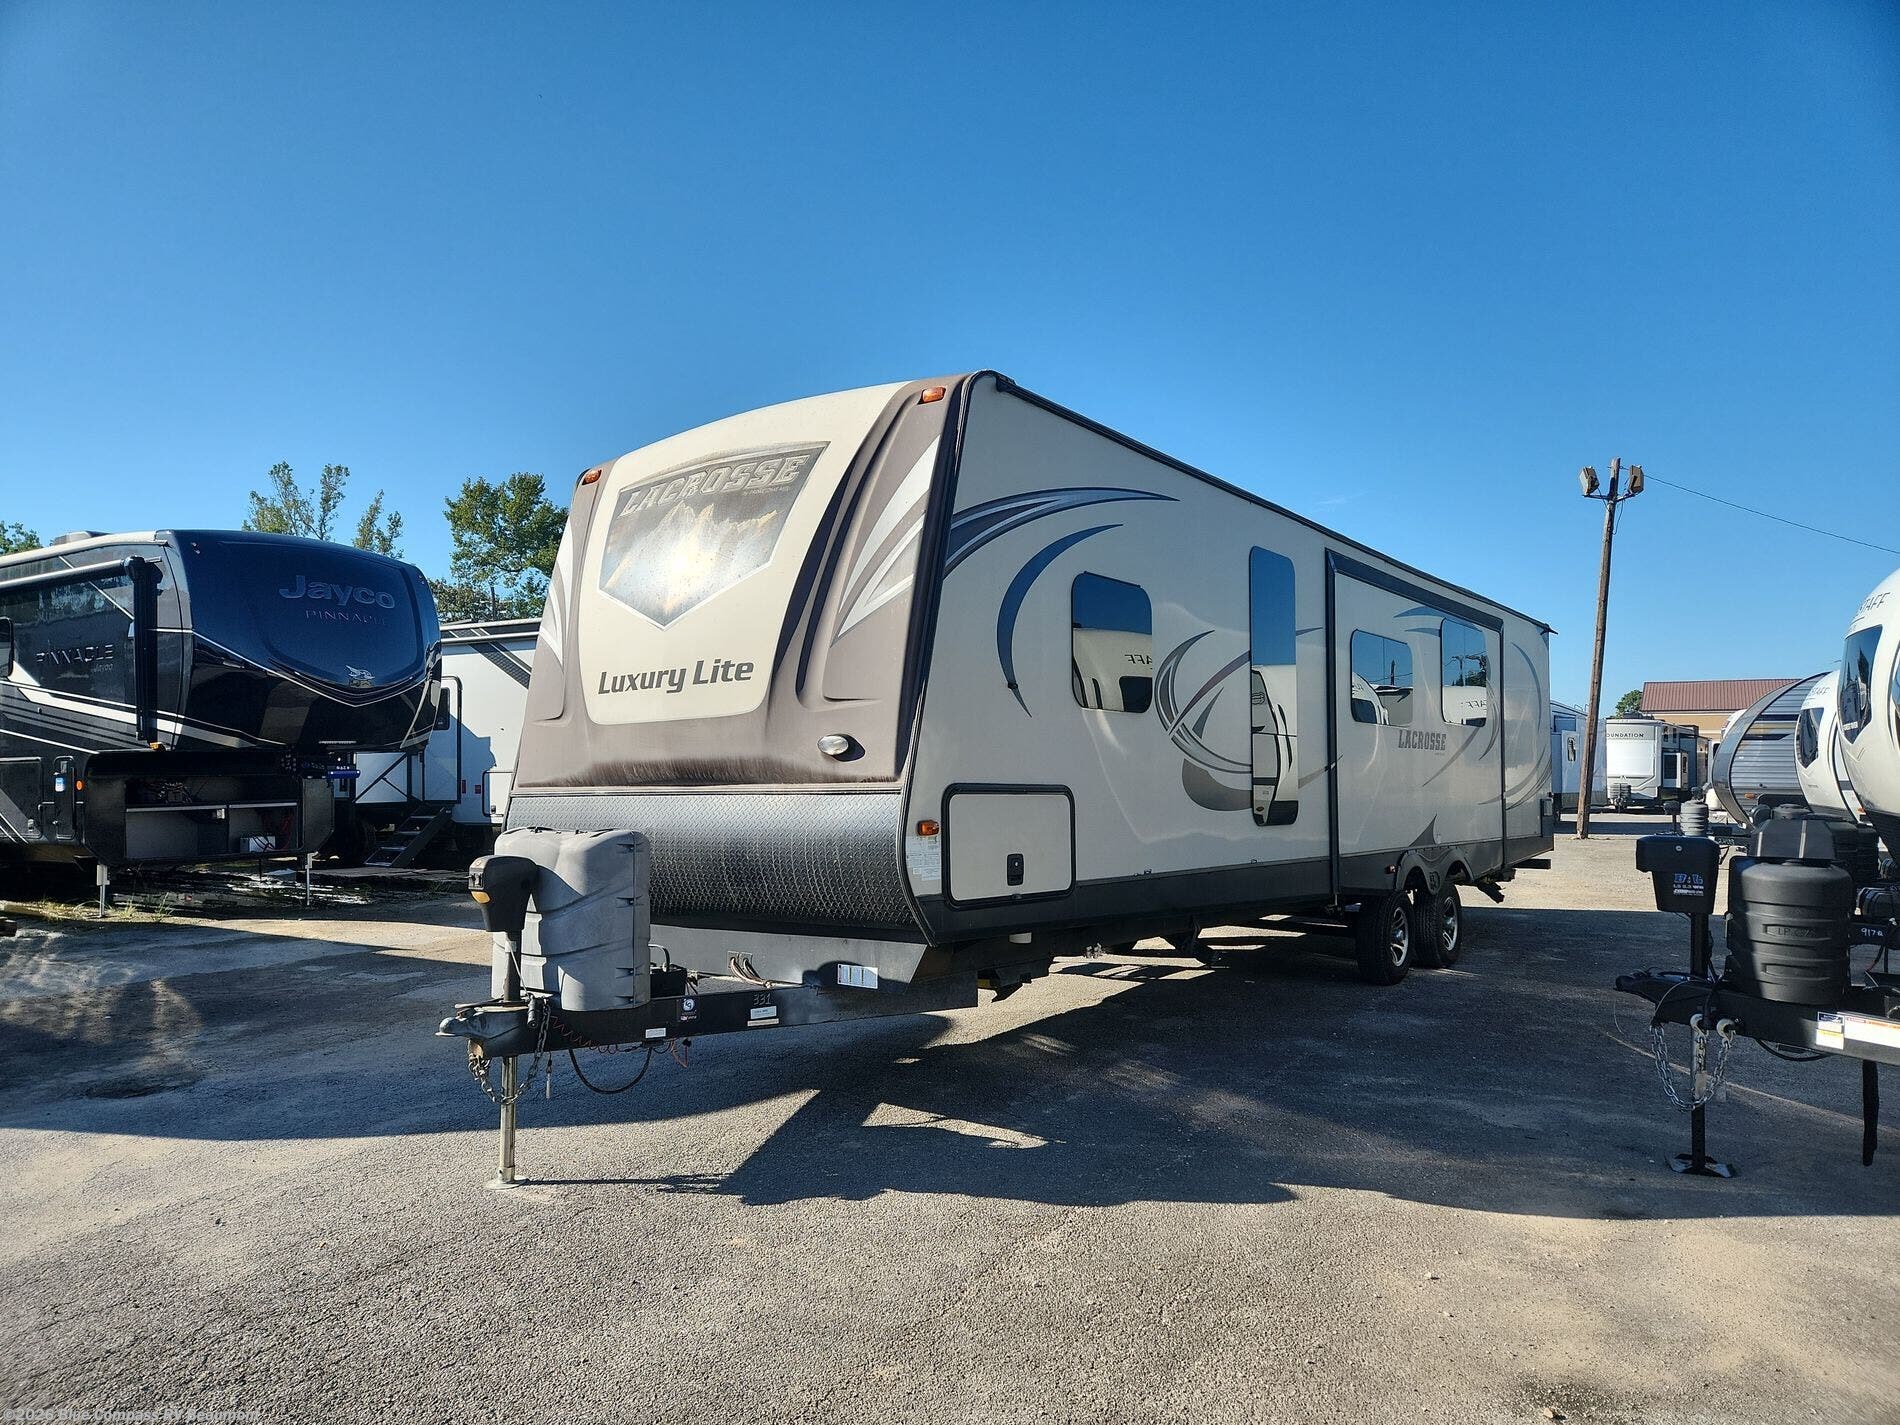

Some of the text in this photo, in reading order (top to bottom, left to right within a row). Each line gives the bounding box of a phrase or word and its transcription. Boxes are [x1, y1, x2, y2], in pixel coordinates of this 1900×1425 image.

[617, 454, 812, 519] LACROSSE
[279, 575, 396, 609] Jayco
[598, 658, 754, 694] Luxury Lite
[1398, 730, 1446, 751] LACROSSE
